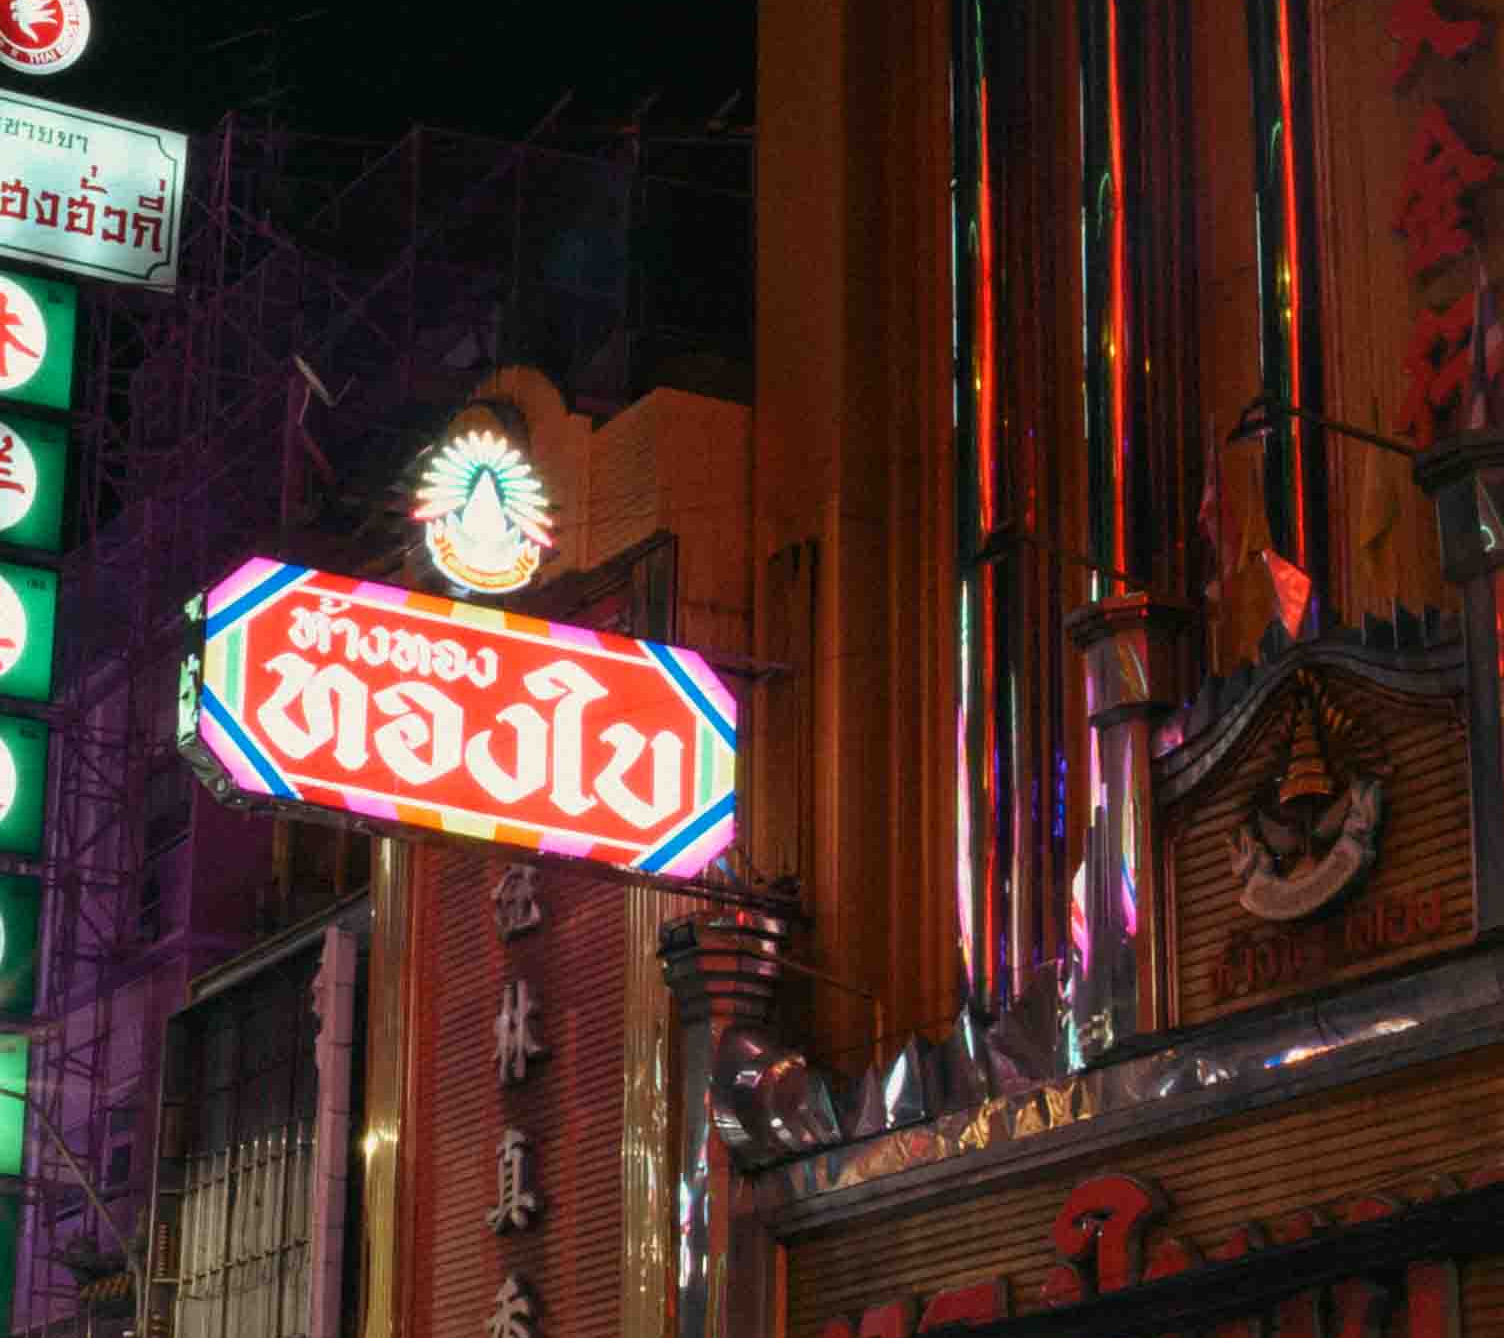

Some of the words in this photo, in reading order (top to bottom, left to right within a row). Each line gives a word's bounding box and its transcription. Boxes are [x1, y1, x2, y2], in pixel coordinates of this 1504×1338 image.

[288, 598, 498, 689] ห้างทอง
[256, 653, 685, 830] ทองใบ
